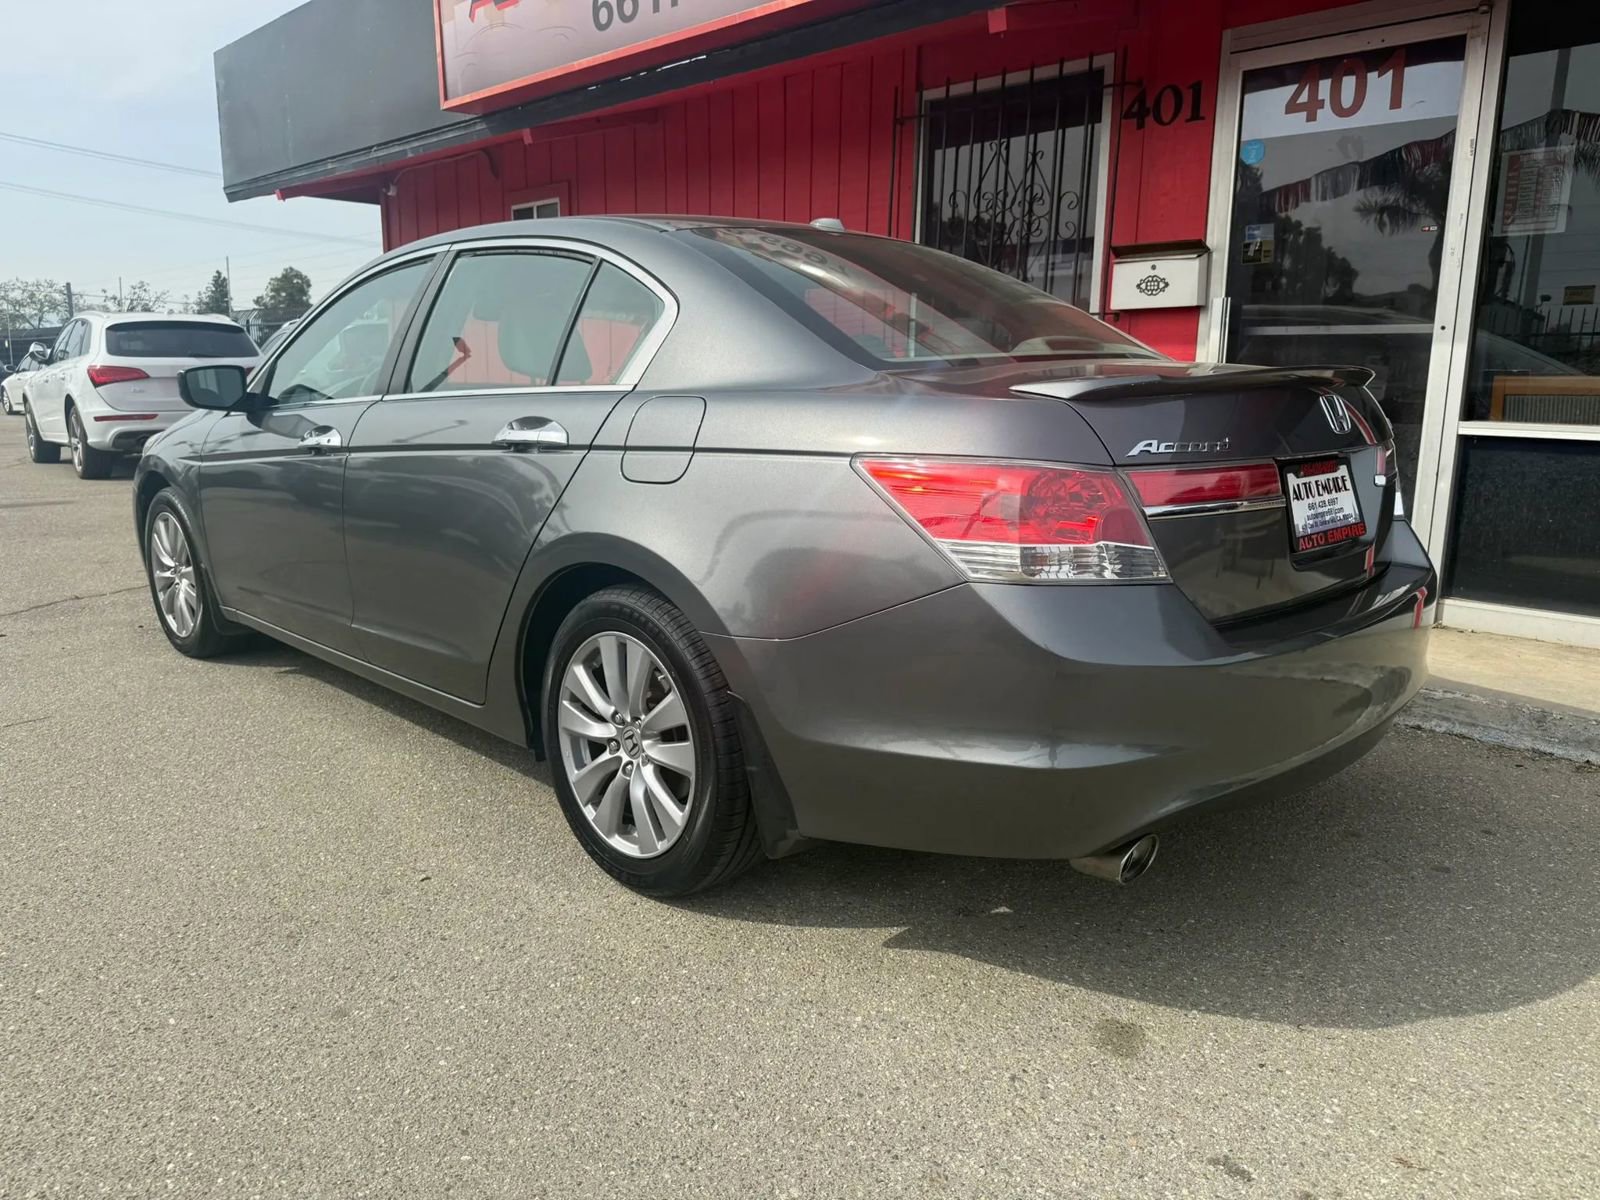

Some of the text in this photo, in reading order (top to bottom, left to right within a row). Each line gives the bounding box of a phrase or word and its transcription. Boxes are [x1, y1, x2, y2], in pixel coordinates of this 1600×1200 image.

[1285, 46, 1406, 123] 401
[1121, 79, 1206, 131] 401
[1125, 437, 1230, 457] Accord
[1292, 475, 1350, 502] AUTO EMPIRE
[1299, 523, 1366, 551] AUTO EMPIRE
